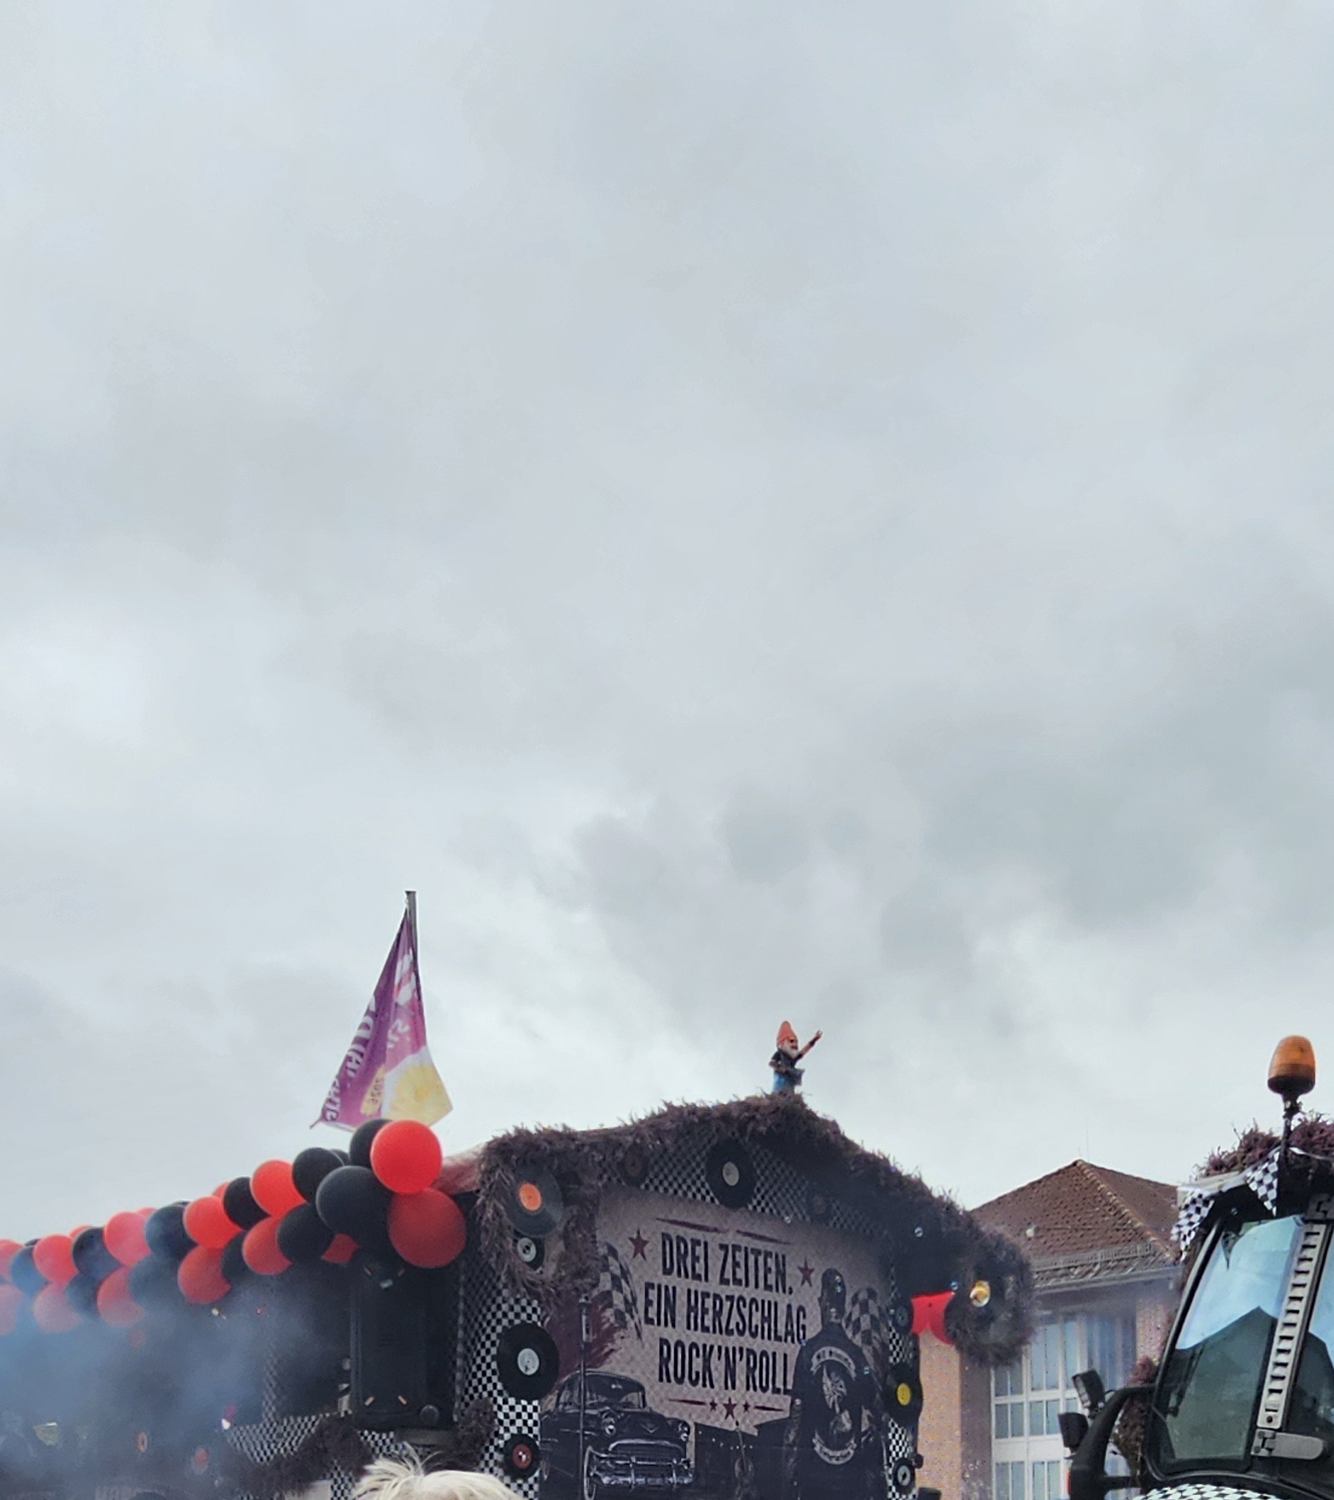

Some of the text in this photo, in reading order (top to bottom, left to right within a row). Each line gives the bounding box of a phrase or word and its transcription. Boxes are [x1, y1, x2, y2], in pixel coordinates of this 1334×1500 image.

[661, 1232, 710, 1283] DREI
[643, 1281, 807, 1345] EIN HERZSCHLAG
[658, 1336, 793, 1396] ROCK'N'ROLL
